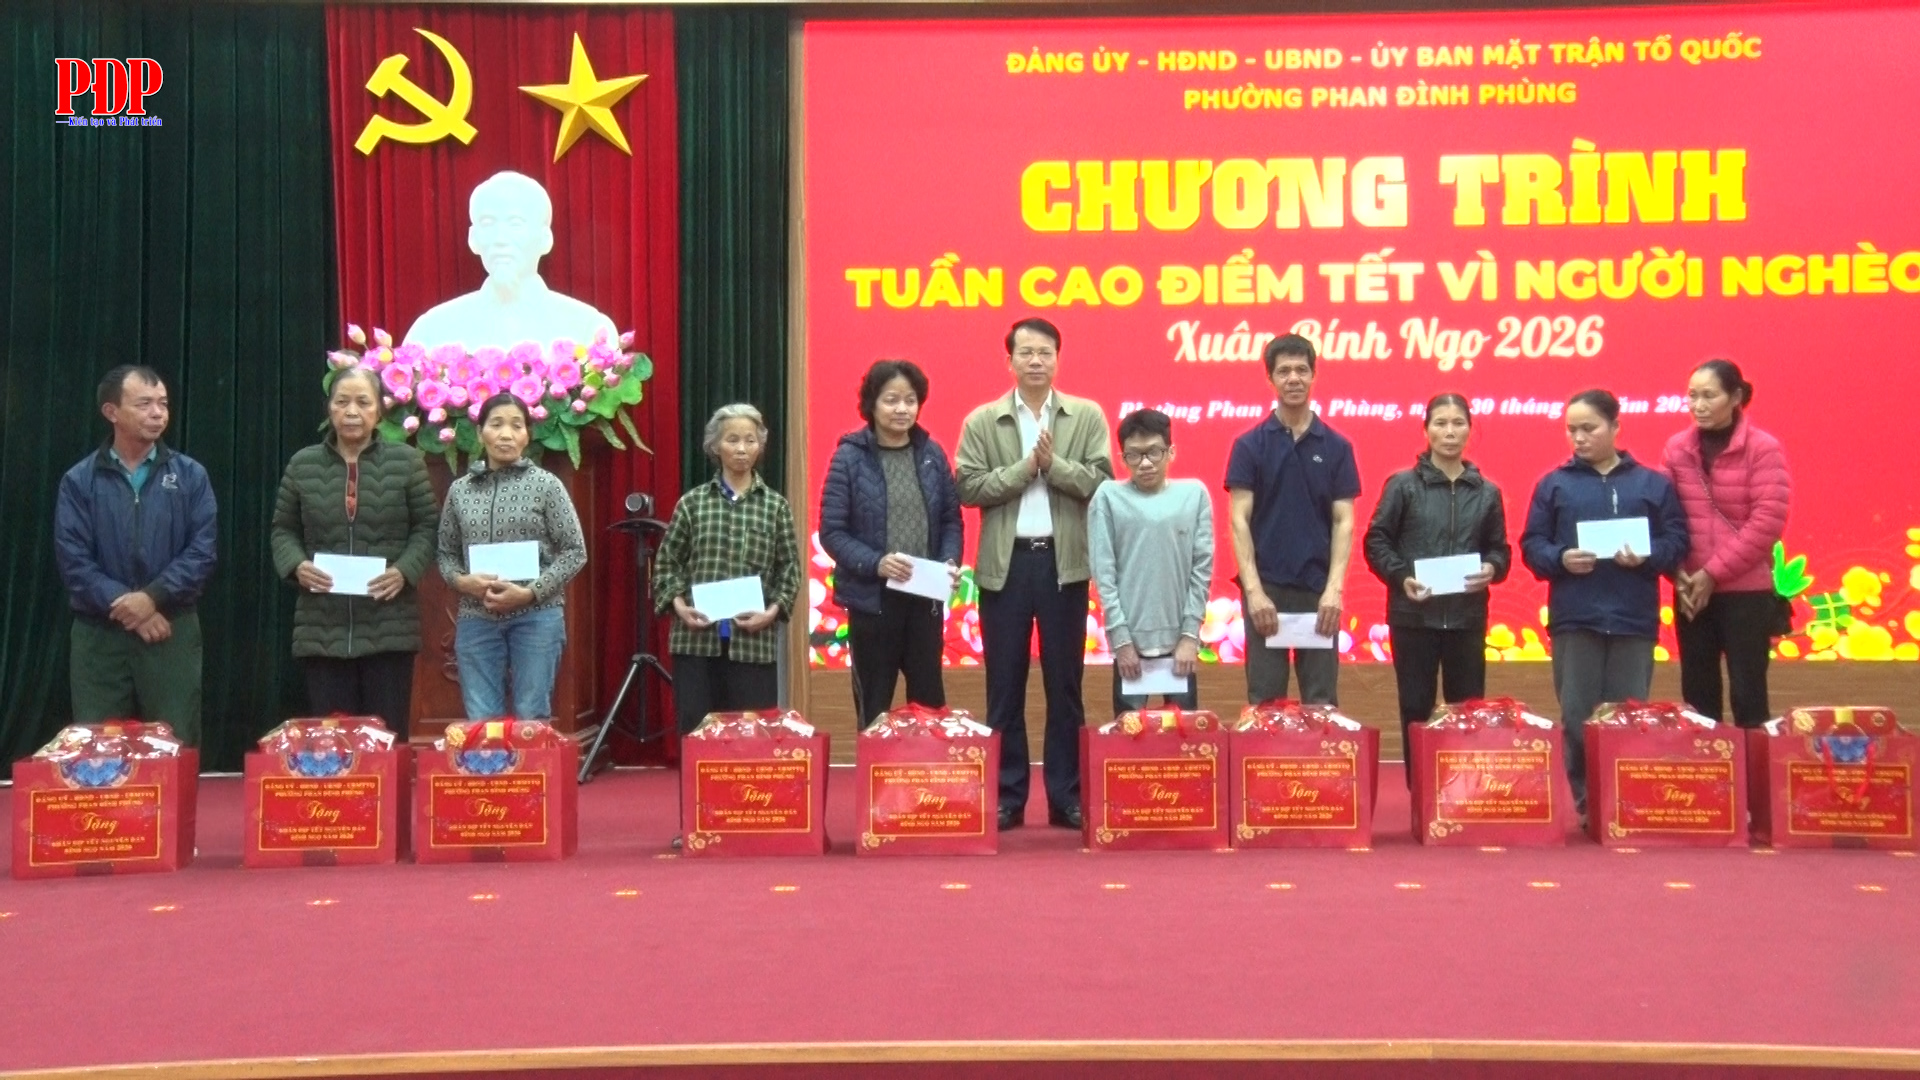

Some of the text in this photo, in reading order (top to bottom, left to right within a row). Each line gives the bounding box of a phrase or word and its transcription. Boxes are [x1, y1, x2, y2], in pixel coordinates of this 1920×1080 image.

[1007, 46, 1084, 73] ĐẢNG
[1093, 45, 1129, 73] ỦY
[1158, 50, 1237, 71] HĐND
[1265, 48, 1342, 70] UBND
[1371, 40, 1408, 68] ỦY
[1417, 45, 1473, 67] BAN
[1482, 38, 1541, 70] MẶT
[1549, 36, 1624, 68] TRẬN
[1680, 31, 1762, 65] QUỐC
[1184, 77, 1576, 110] PHƯỜNG PHAN ĐÌNH PHÙNG
[1021, 137, 1746, 232] CHƯƠNG TRÌNH
[844, 241, 1920, 308] TUẦN CAO ĐIỂM TẾT VÌ NGƯỜI NGHÈO
[1290, 318, 1392, 361] Bính
[1400, 316, 1492, 371] Ngọ
[1494, 315, 1605, 358] 2026
[1207, 400, 1262, 418] Phan
[1470, 398, 1495, 415] 30
[1500, 396, 1565, 419] tháng
[1619, 396, 1649, 413] ăm
[741, 784, 772, 806] Tặng
[1149, 782, 1180, 804] Tặng
[1288, 781, 1319, 802] Tặng
[1662, 783, 1695, 806] Tặng
[307, 800, 341, 822] Tặng
[476, 798, 508, 820] Tặng
[82, 811, 118, 835] Tặng
